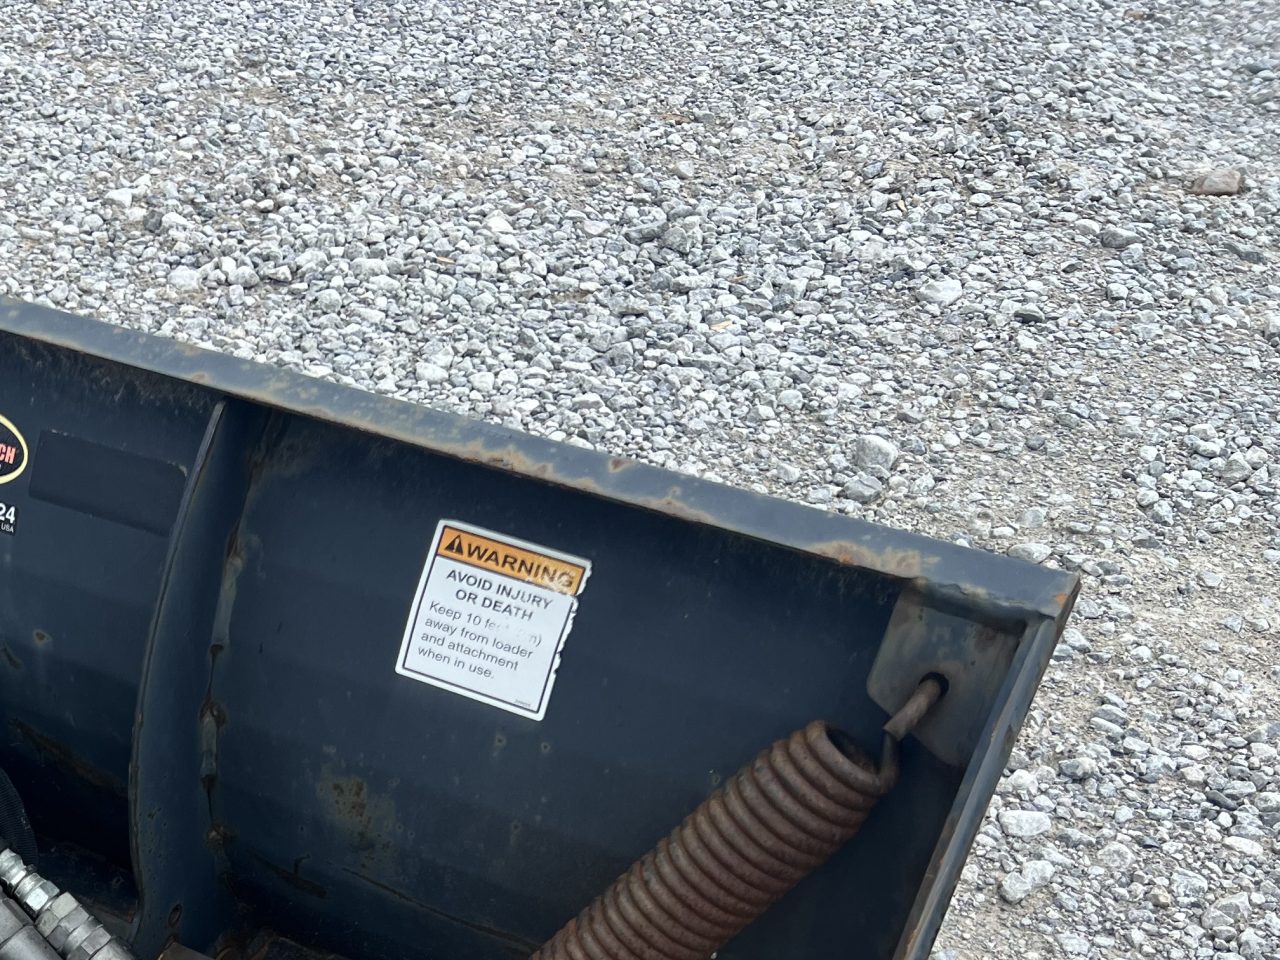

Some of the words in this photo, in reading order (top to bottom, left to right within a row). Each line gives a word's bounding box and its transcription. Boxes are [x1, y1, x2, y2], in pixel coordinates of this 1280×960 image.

[0, 522, 14, 533] USA
[467, 543, 577, 588] WARNING
[446, 569, 493, 591] AVOID
[496, 584, 553, 610] INJURY
[455, 589, 478, 605] OR
[481, 597, 534, 621] DEATH
[429, 601, 462, 620] Keep
[466, 613, 482, 626] 10
[420, 632, 445, 647] and
[447, 640, 519, 671] attachment
[424, 617, 457, 635] away
[460, 627, 489, 645] from
[492, 637, 534, 659] loader
[417, 646, 451, 665] when
[454, 657, 465, 670] in
[469, 664, 495, 679] use.
